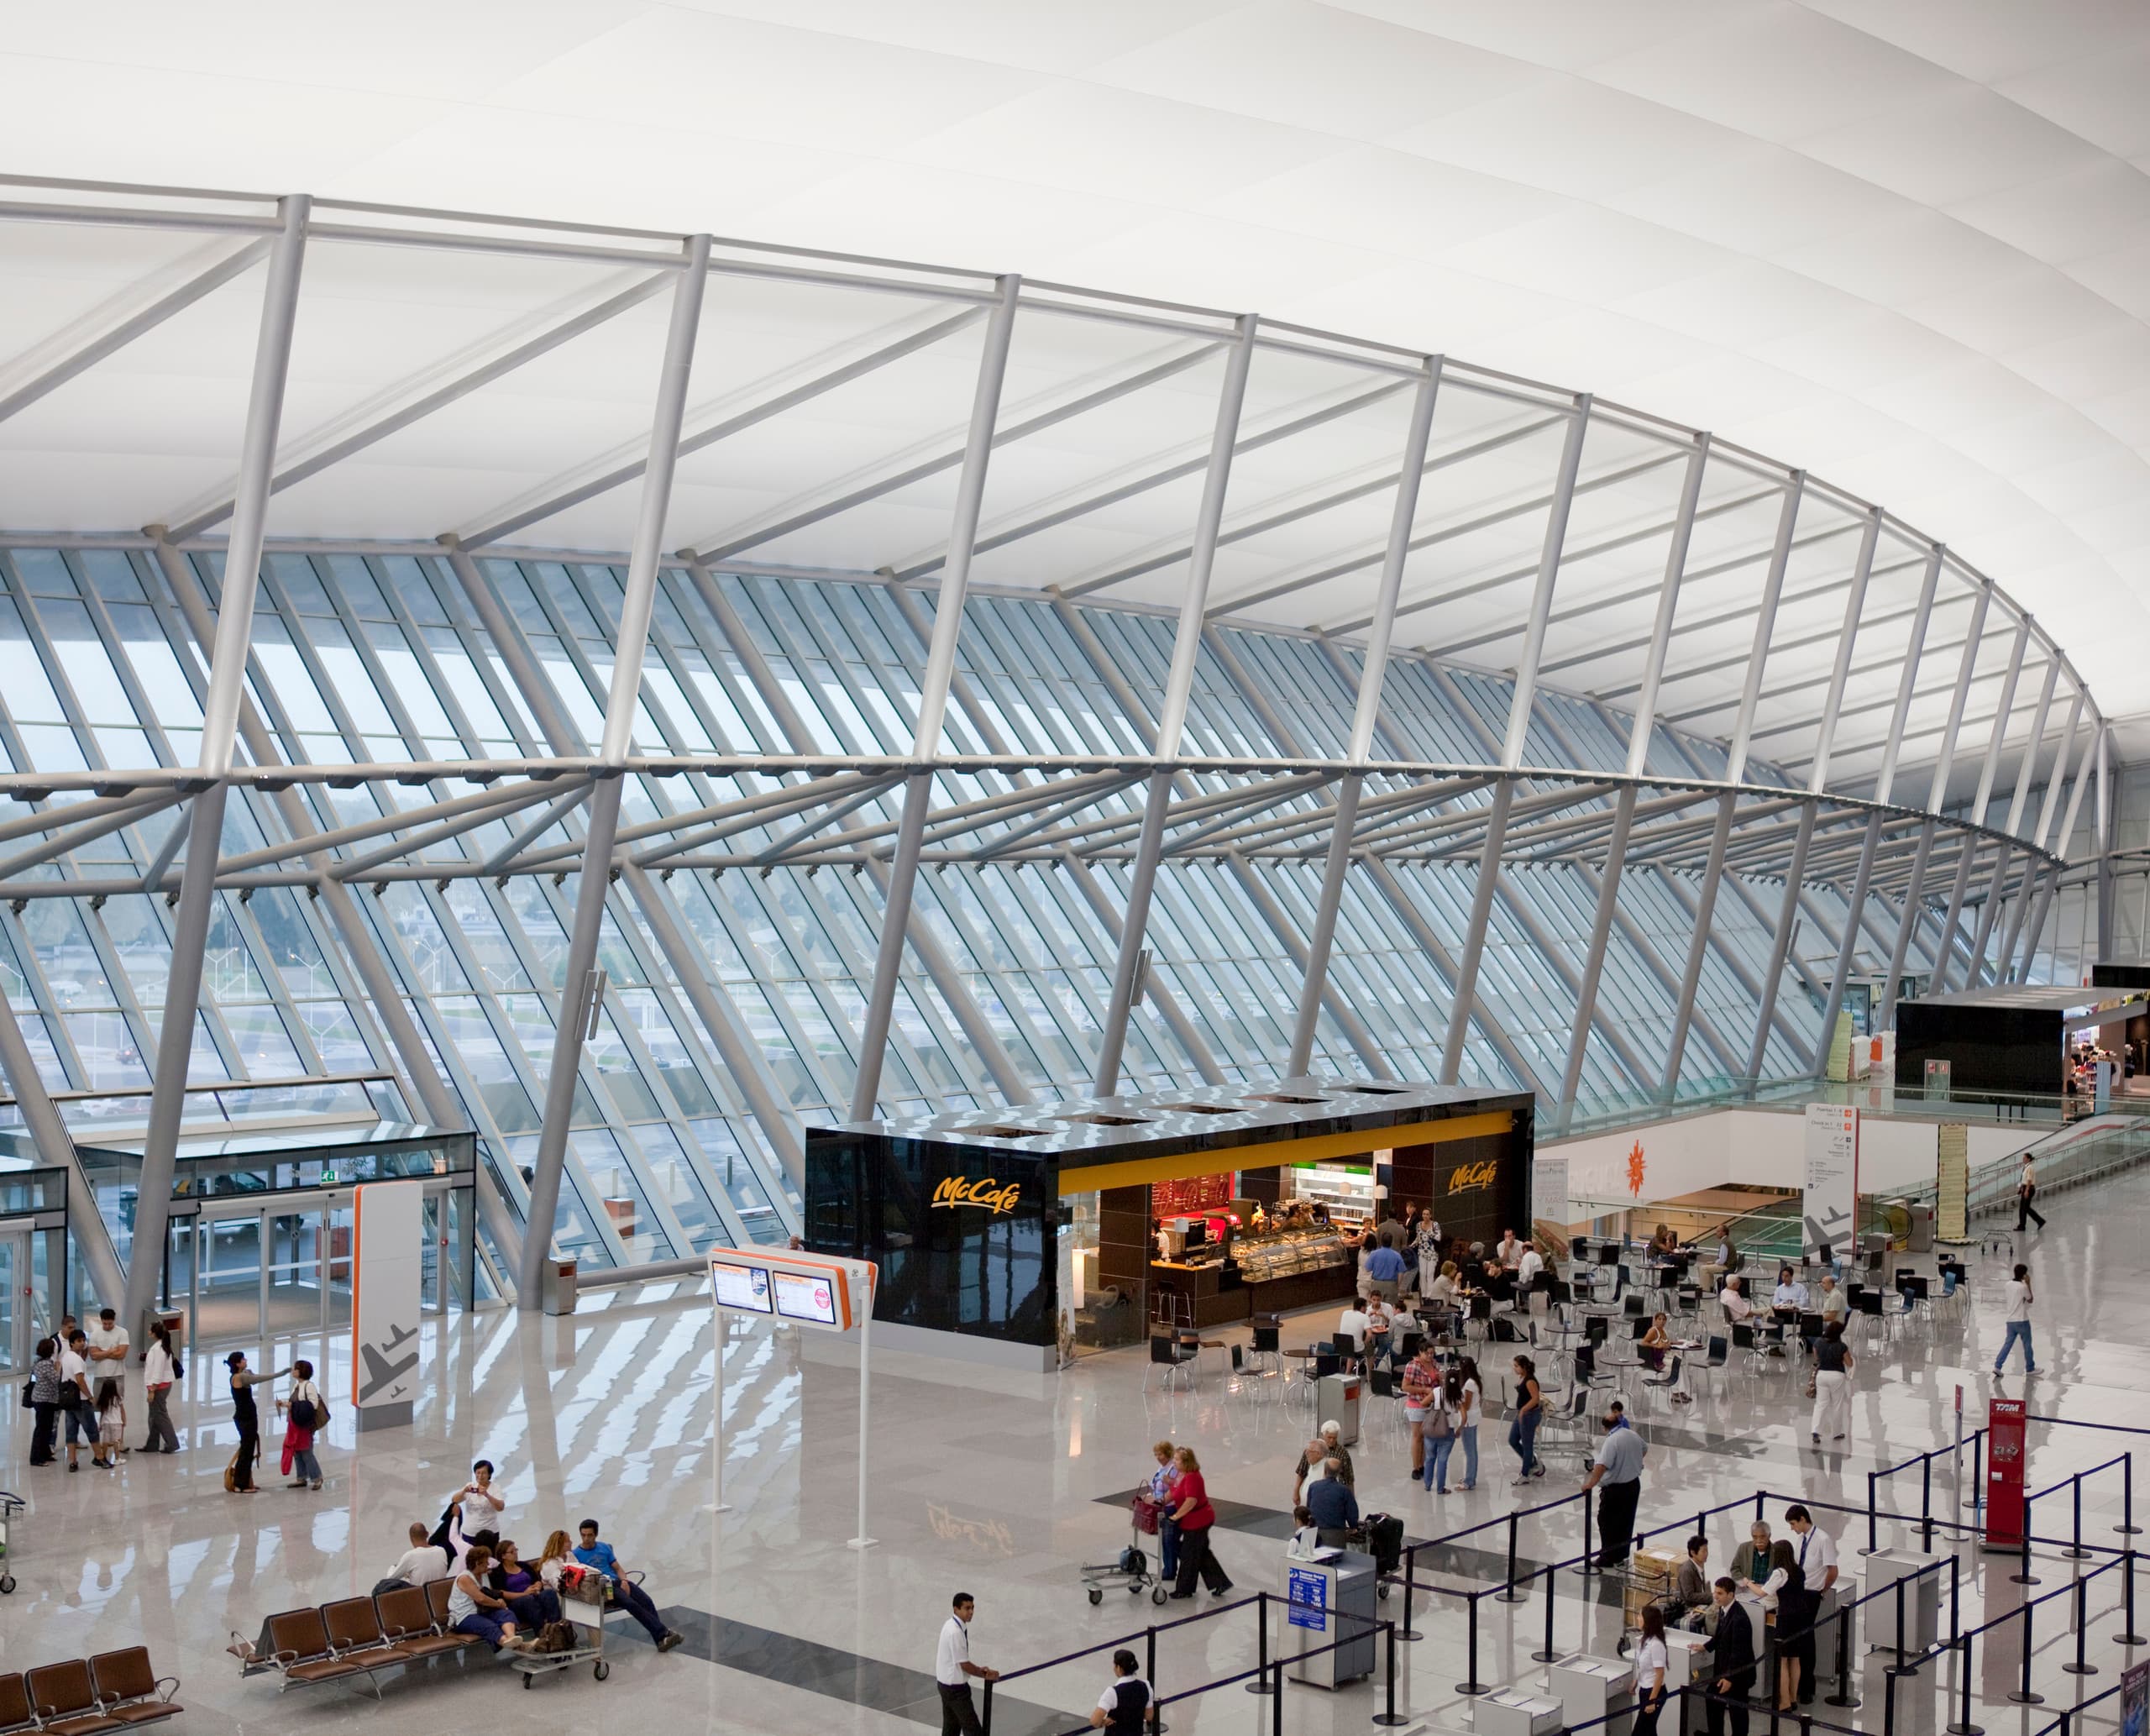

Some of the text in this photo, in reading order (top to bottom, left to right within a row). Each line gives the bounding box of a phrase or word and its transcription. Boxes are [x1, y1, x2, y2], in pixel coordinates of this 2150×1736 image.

[1448, 1160, 1497, 1194] McCafé
[931, 1175, 1020, 1214] McCafé
[1995, 1403, 2020, 1412] TAM
